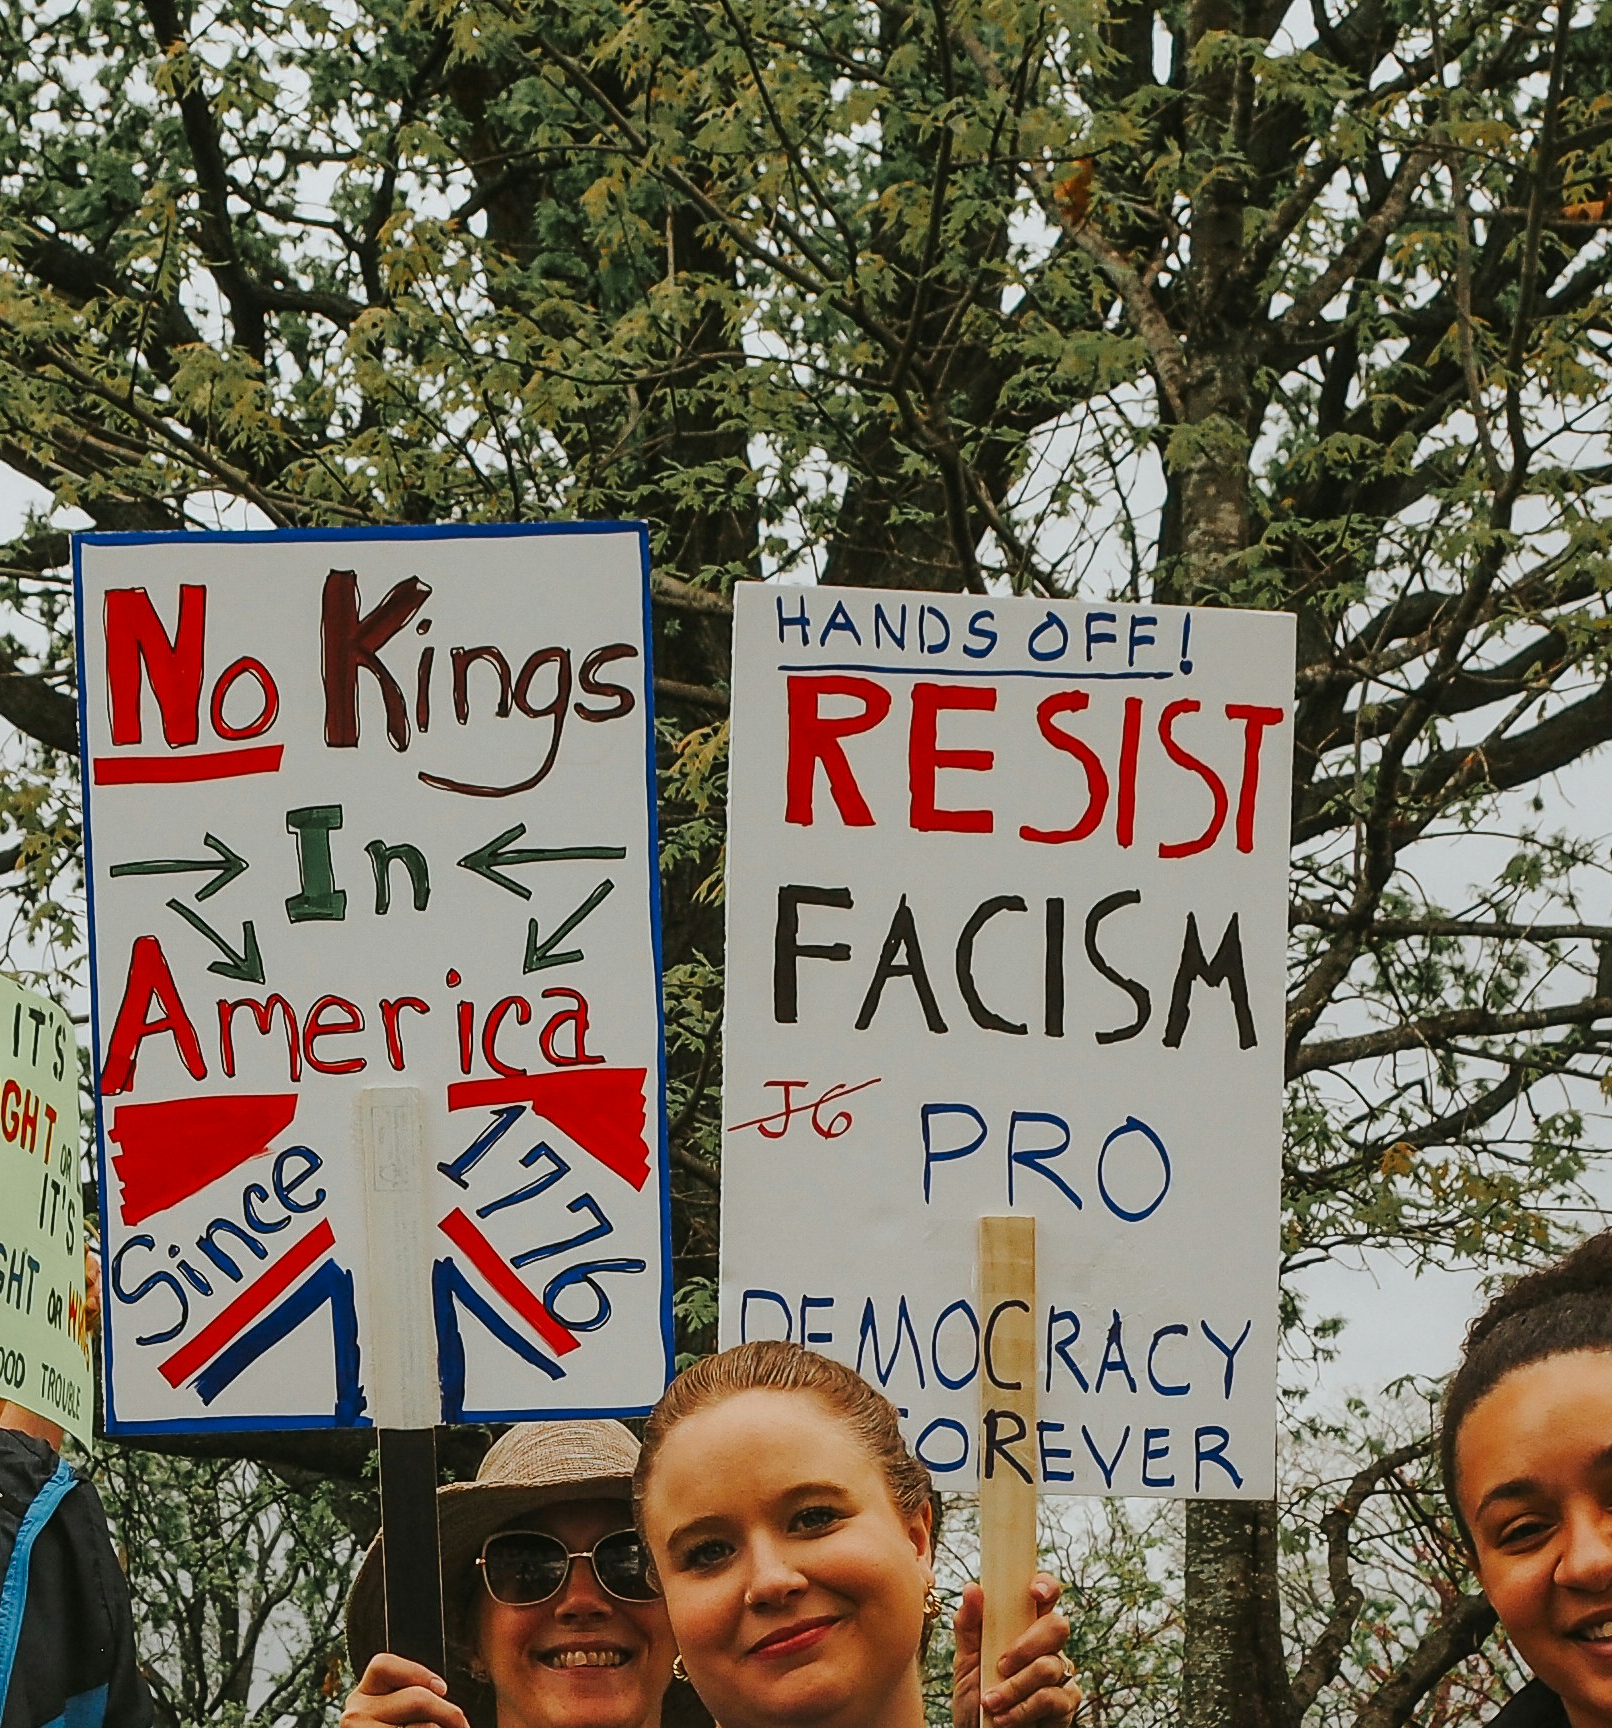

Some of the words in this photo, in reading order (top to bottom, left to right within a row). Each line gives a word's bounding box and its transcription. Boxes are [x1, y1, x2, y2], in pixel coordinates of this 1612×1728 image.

[103, 583, 279, 750] No
[320, 568, 638, 798] Kings
[776, 594, 998, 660] HANDS
[1027, 610, 1194, 676] OFF!
[785, 675, 1284, 860] RESIST
[285, 804, 431, 923] In
[100, 935, 607, 1096] America
[772, 884, 1258, 1051] FACISM
[12, 1002, 67, 1082] IT'S
[39, 1172, 76, 1256] IT'S
[437, 1105, 646, 1333] 1776
[920, 1102, 1172, 1223] PRO
[111, 1144, 327, 1346] Since
[46, 1287, 63, 1331] OR
[740, 1288, 1252, 1400] DEMOCRACY
[40, 1361, 82, 1422] TROUBLE
[896, 1406, 1245, 1493] OREVER
